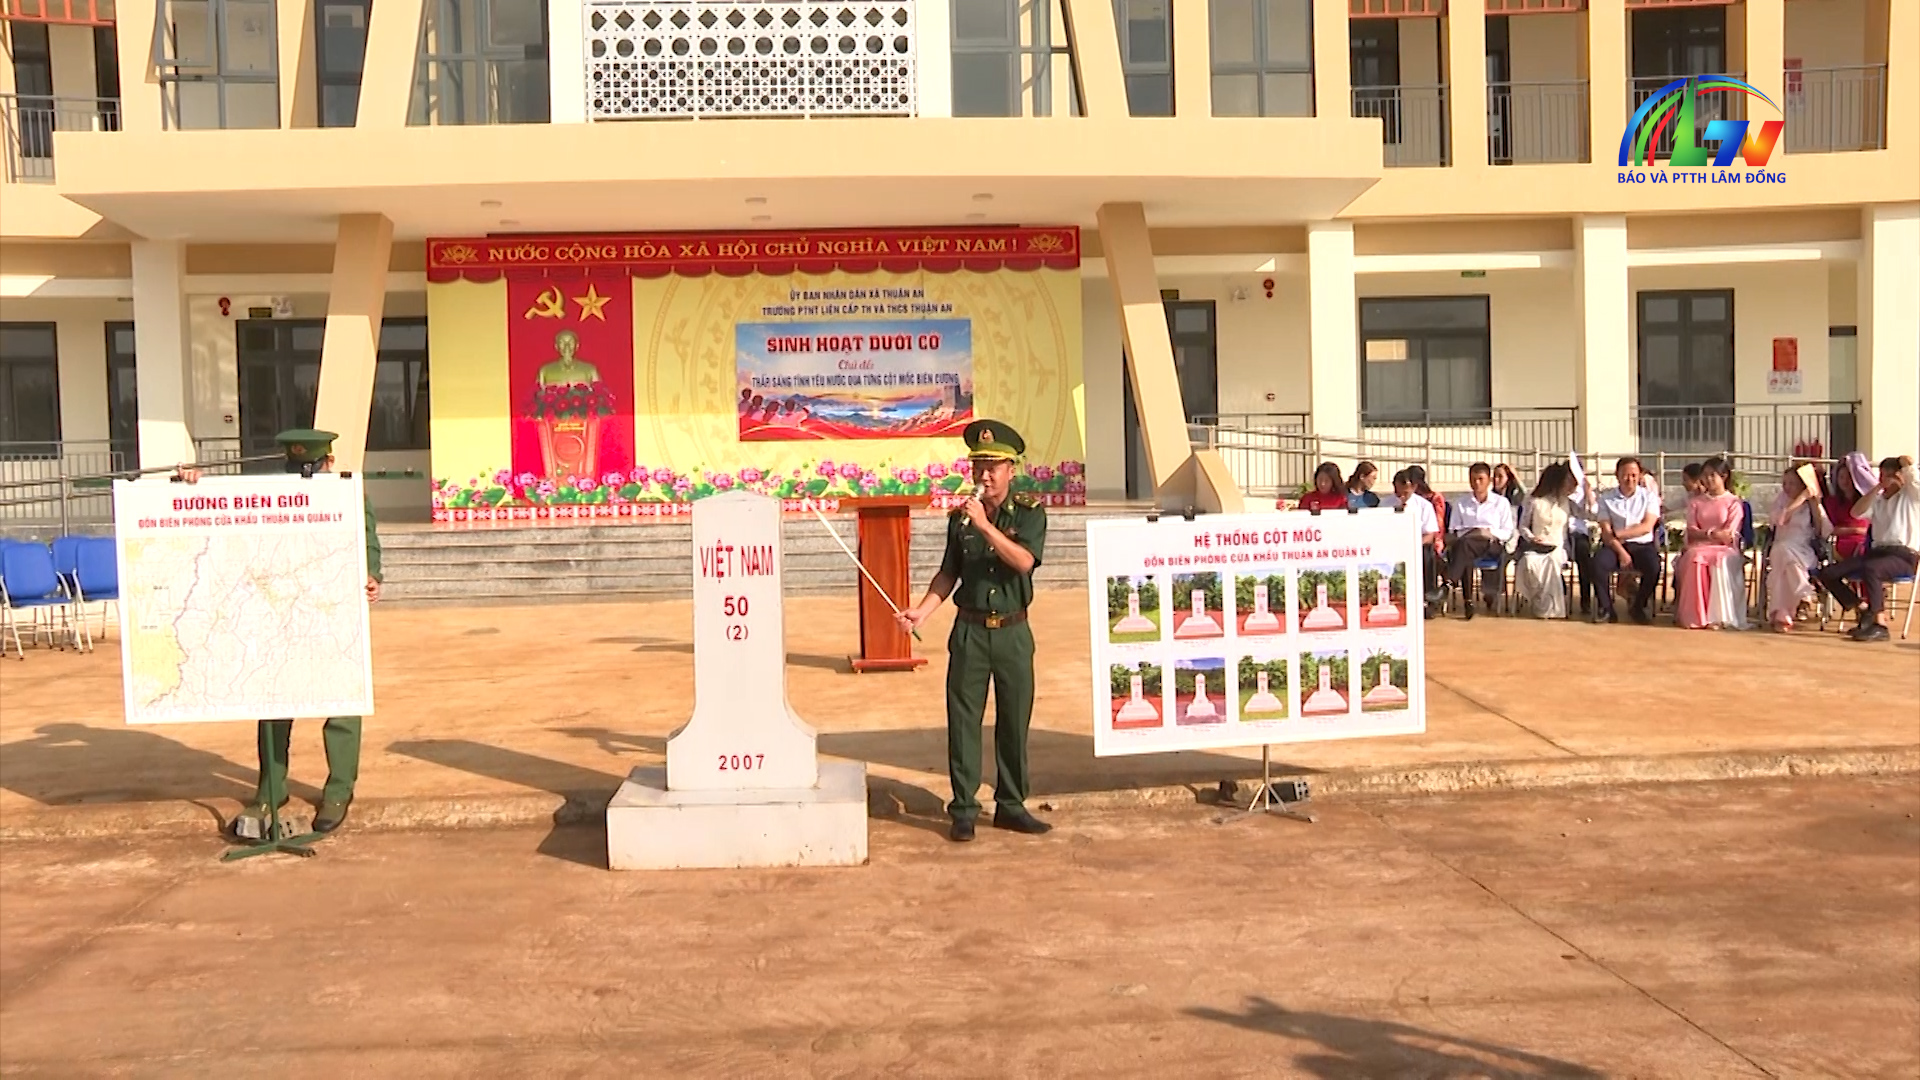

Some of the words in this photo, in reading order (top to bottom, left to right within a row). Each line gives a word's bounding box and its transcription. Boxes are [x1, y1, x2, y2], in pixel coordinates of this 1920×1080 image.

[488, 243, 549, 261] NƯỚC
[554, 242, 618, 263] CỘNG
[623, 241, 672, 259] HÒA
[679, 241, 711, 257] XÃ
[718, 239, 759, 260] HỘI
[765, 236, 810, 256] CHỦ
[897, 235, 949, 256] VIỆT
[955, 238, 1006, 252] NAM
[803, 291, 821, 300] BAN
[823, 289, 847, 300] NHÂN
[849, 289, 866, 299] DÂN
[869, 288, 880, 299] XÃ
[883, 287, 910, 301] THUẬN
[913, 289, 924, 299] AN
[762, 305, 796, 316] TRƯỜNG
[798, 305, 819, 315] PTNT
[821, 303, 840, 315] LIÊN
[842, 301, 859, 314] CẤP
[862, 305, 872, 314] TH
[873, 303, 885, 314] VÀ
[888, 303, 908, 314] THCS
[911, 302, 938, 315] THUẬN
[941, 303, 953, 313] AN
[767, 336, 811, 353] SINH
[816, 335, 863, 354] HOẠT
[869, 332, 913, 351] DƯỚI
[918, 331, 941, 350] CỜ
[772, 374, 792, 388] SÁNG
[793, 373, 811, 388] TÌNH
[812, 374, 825, 387] YÊU
[826, 373, 847, 387] NƯỚC
[848, 375, 862, 387] QUA
[883, 371, 897, 387] CỘT
[898, 371, 915, 386] MỐC
[917, 372, 934, 385] BIÊN
[173, 494, 228, 510] ĐƯỜNG
[234, 493, 272, 509] BIÊN
[277, 492, 310, 508] GIỚI
[160, 516, 180, 528] BIÊN
[182, 516, 212, 527] PHÒNG
[262, 512, 290, 525] THUẬN
[292, 513, 305, 524] AN
[1194, 532, 1211, 549] HỆ
[1215, 528, 1259, 546] THỐNG
[1263, 528, 1288, 547] CỘT
[1293, 525, 1323, 543] MỐC
[700, 538, 734, 583] VIỆT
[740, 544, 774, 577] NAM
[1168, 554, 1191, 566] BIÊN
[1194, 552, 1228, 565] PHÒNG
[1282, 548, 1313, 561] THUẬN
[1316, 549, 1329, 558] AN
[724, 595, 749, 617] 50
[726, 625, 749, 640] (2)
[718, 754, 765, 770] 2007
